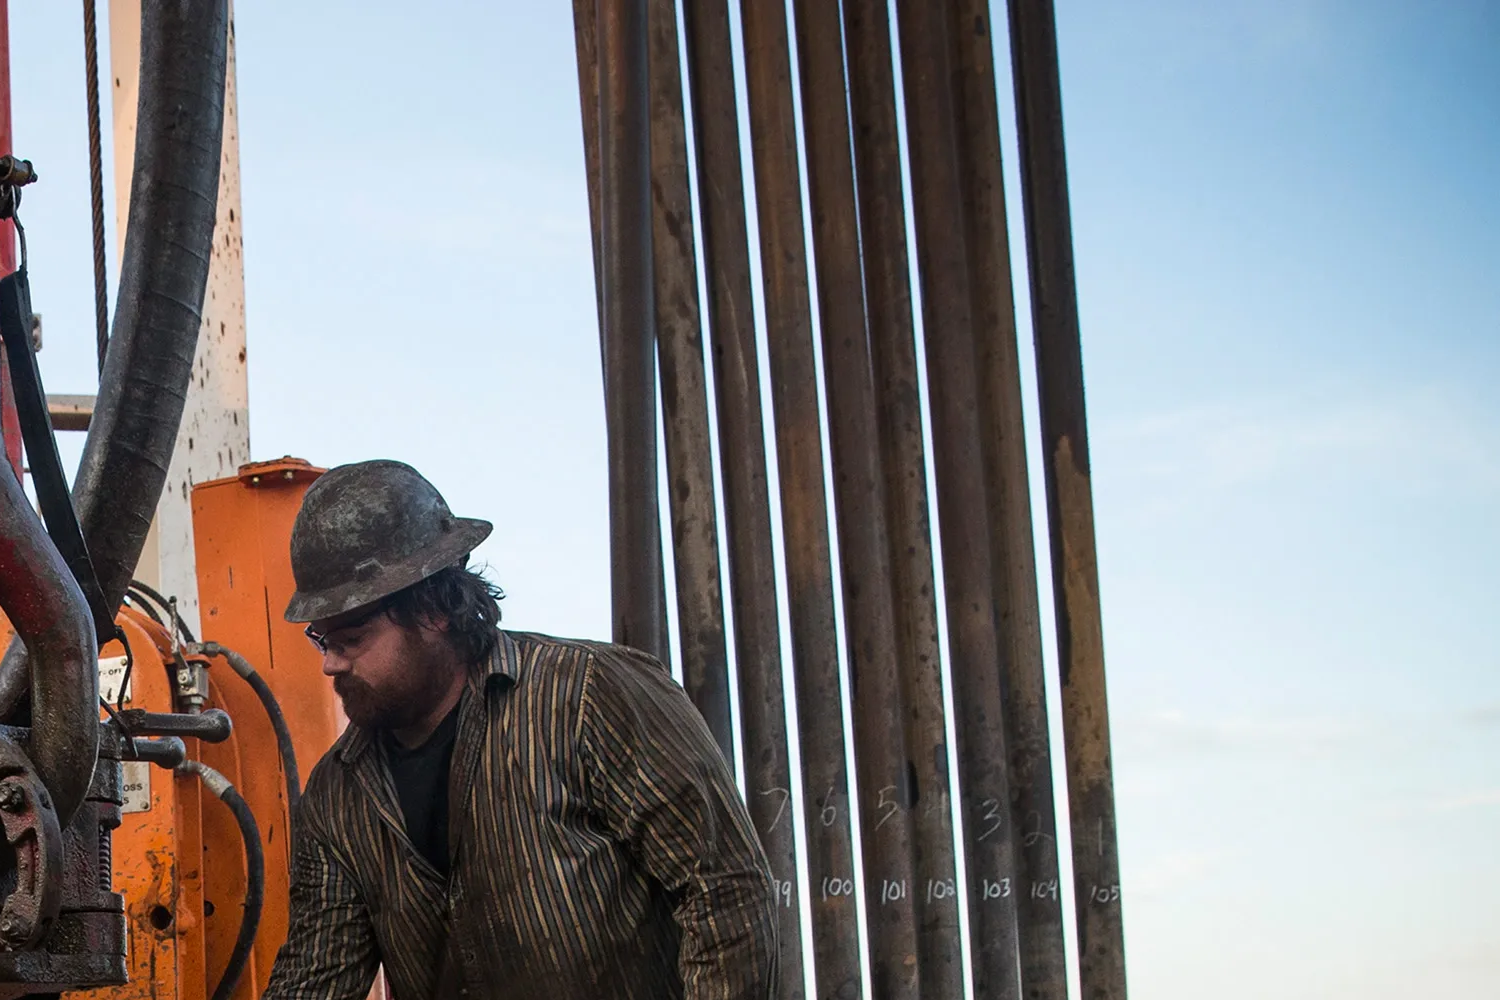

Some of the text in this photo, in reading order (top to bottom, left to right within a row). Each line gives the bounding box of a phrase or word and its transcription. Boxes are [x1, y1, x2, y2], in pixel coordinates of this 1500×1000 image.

[123, 784, 143, 792] OSS
[760, 787, 789, 833] 7
[821, 786, 836, 827] 6
[875, 785, 897, 831] 5
[978, 799, 1001, 841] 3
[1024, 810, 1053, 847] 2
[823, 877, 853, 902] 100
[882, 880, 905, 905] 101
[927, 878, 956, 904] 102
[983, 878, 1011, 900] 103
[1031, 880, 1058, 901] 104
[1089, 884, 1121, 905] 105
